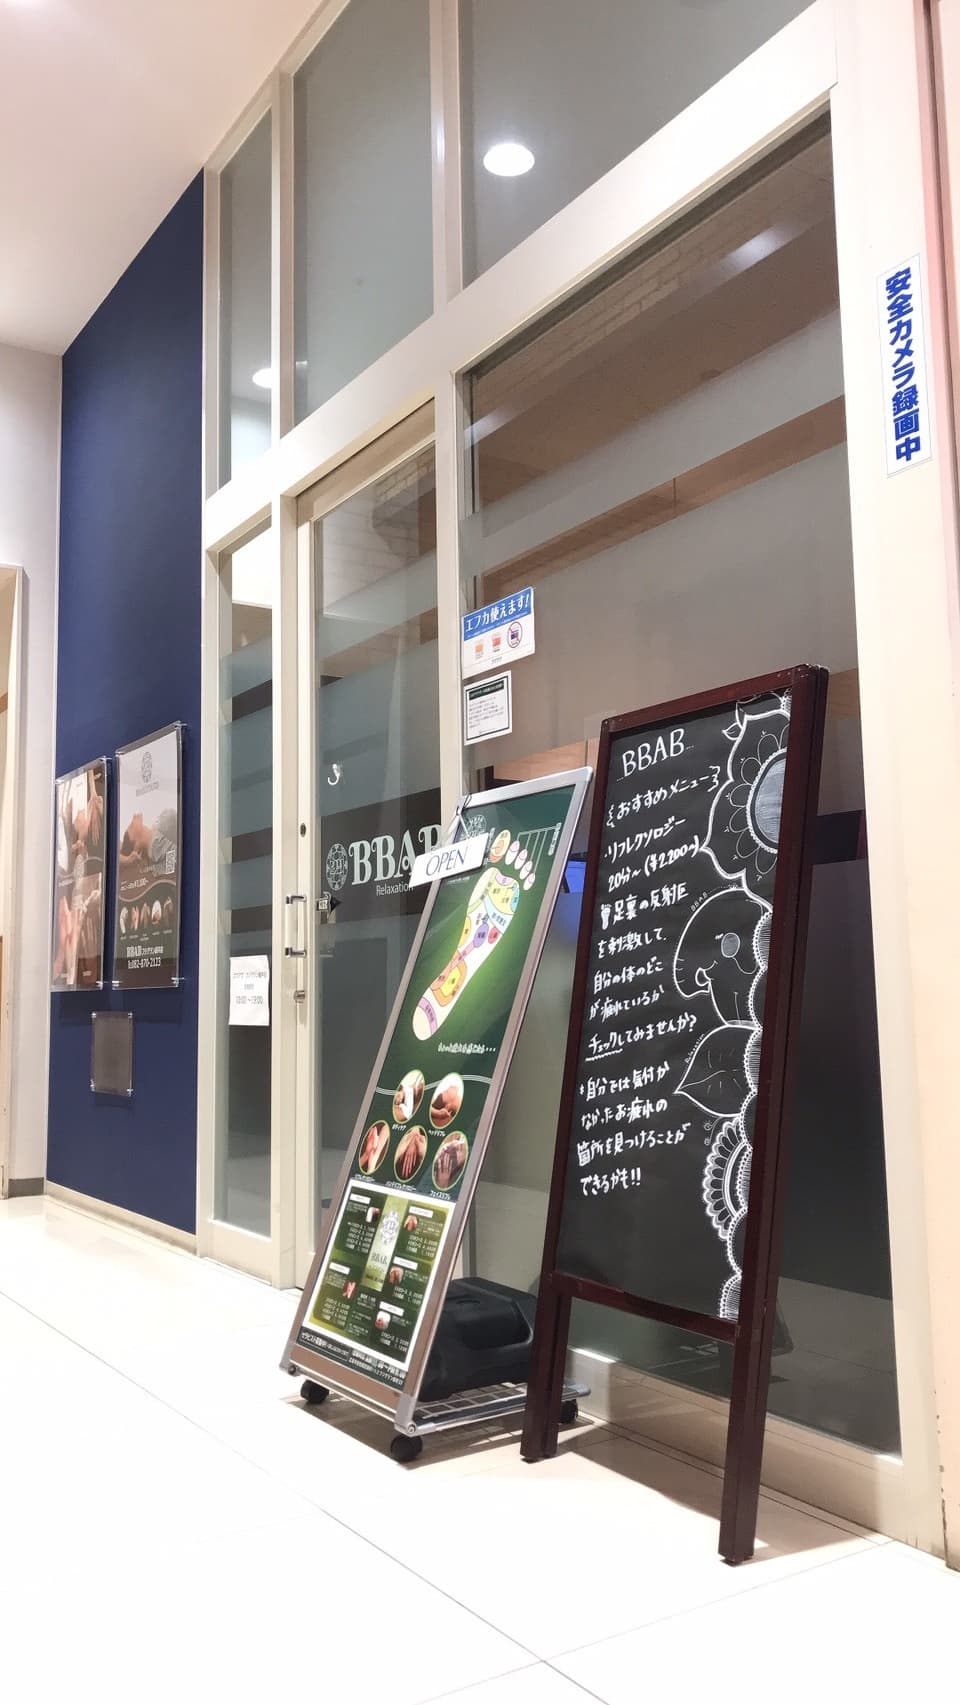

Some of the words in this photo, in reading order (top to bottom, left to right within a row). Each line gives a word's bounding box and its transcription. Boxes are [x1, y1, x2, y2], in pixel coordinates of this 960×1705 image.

[885, 266, 921, 462] 安全カメラ録画中
[622, 727, 685, 777] BBAB
[426, 846, 469, 876] OPEN
